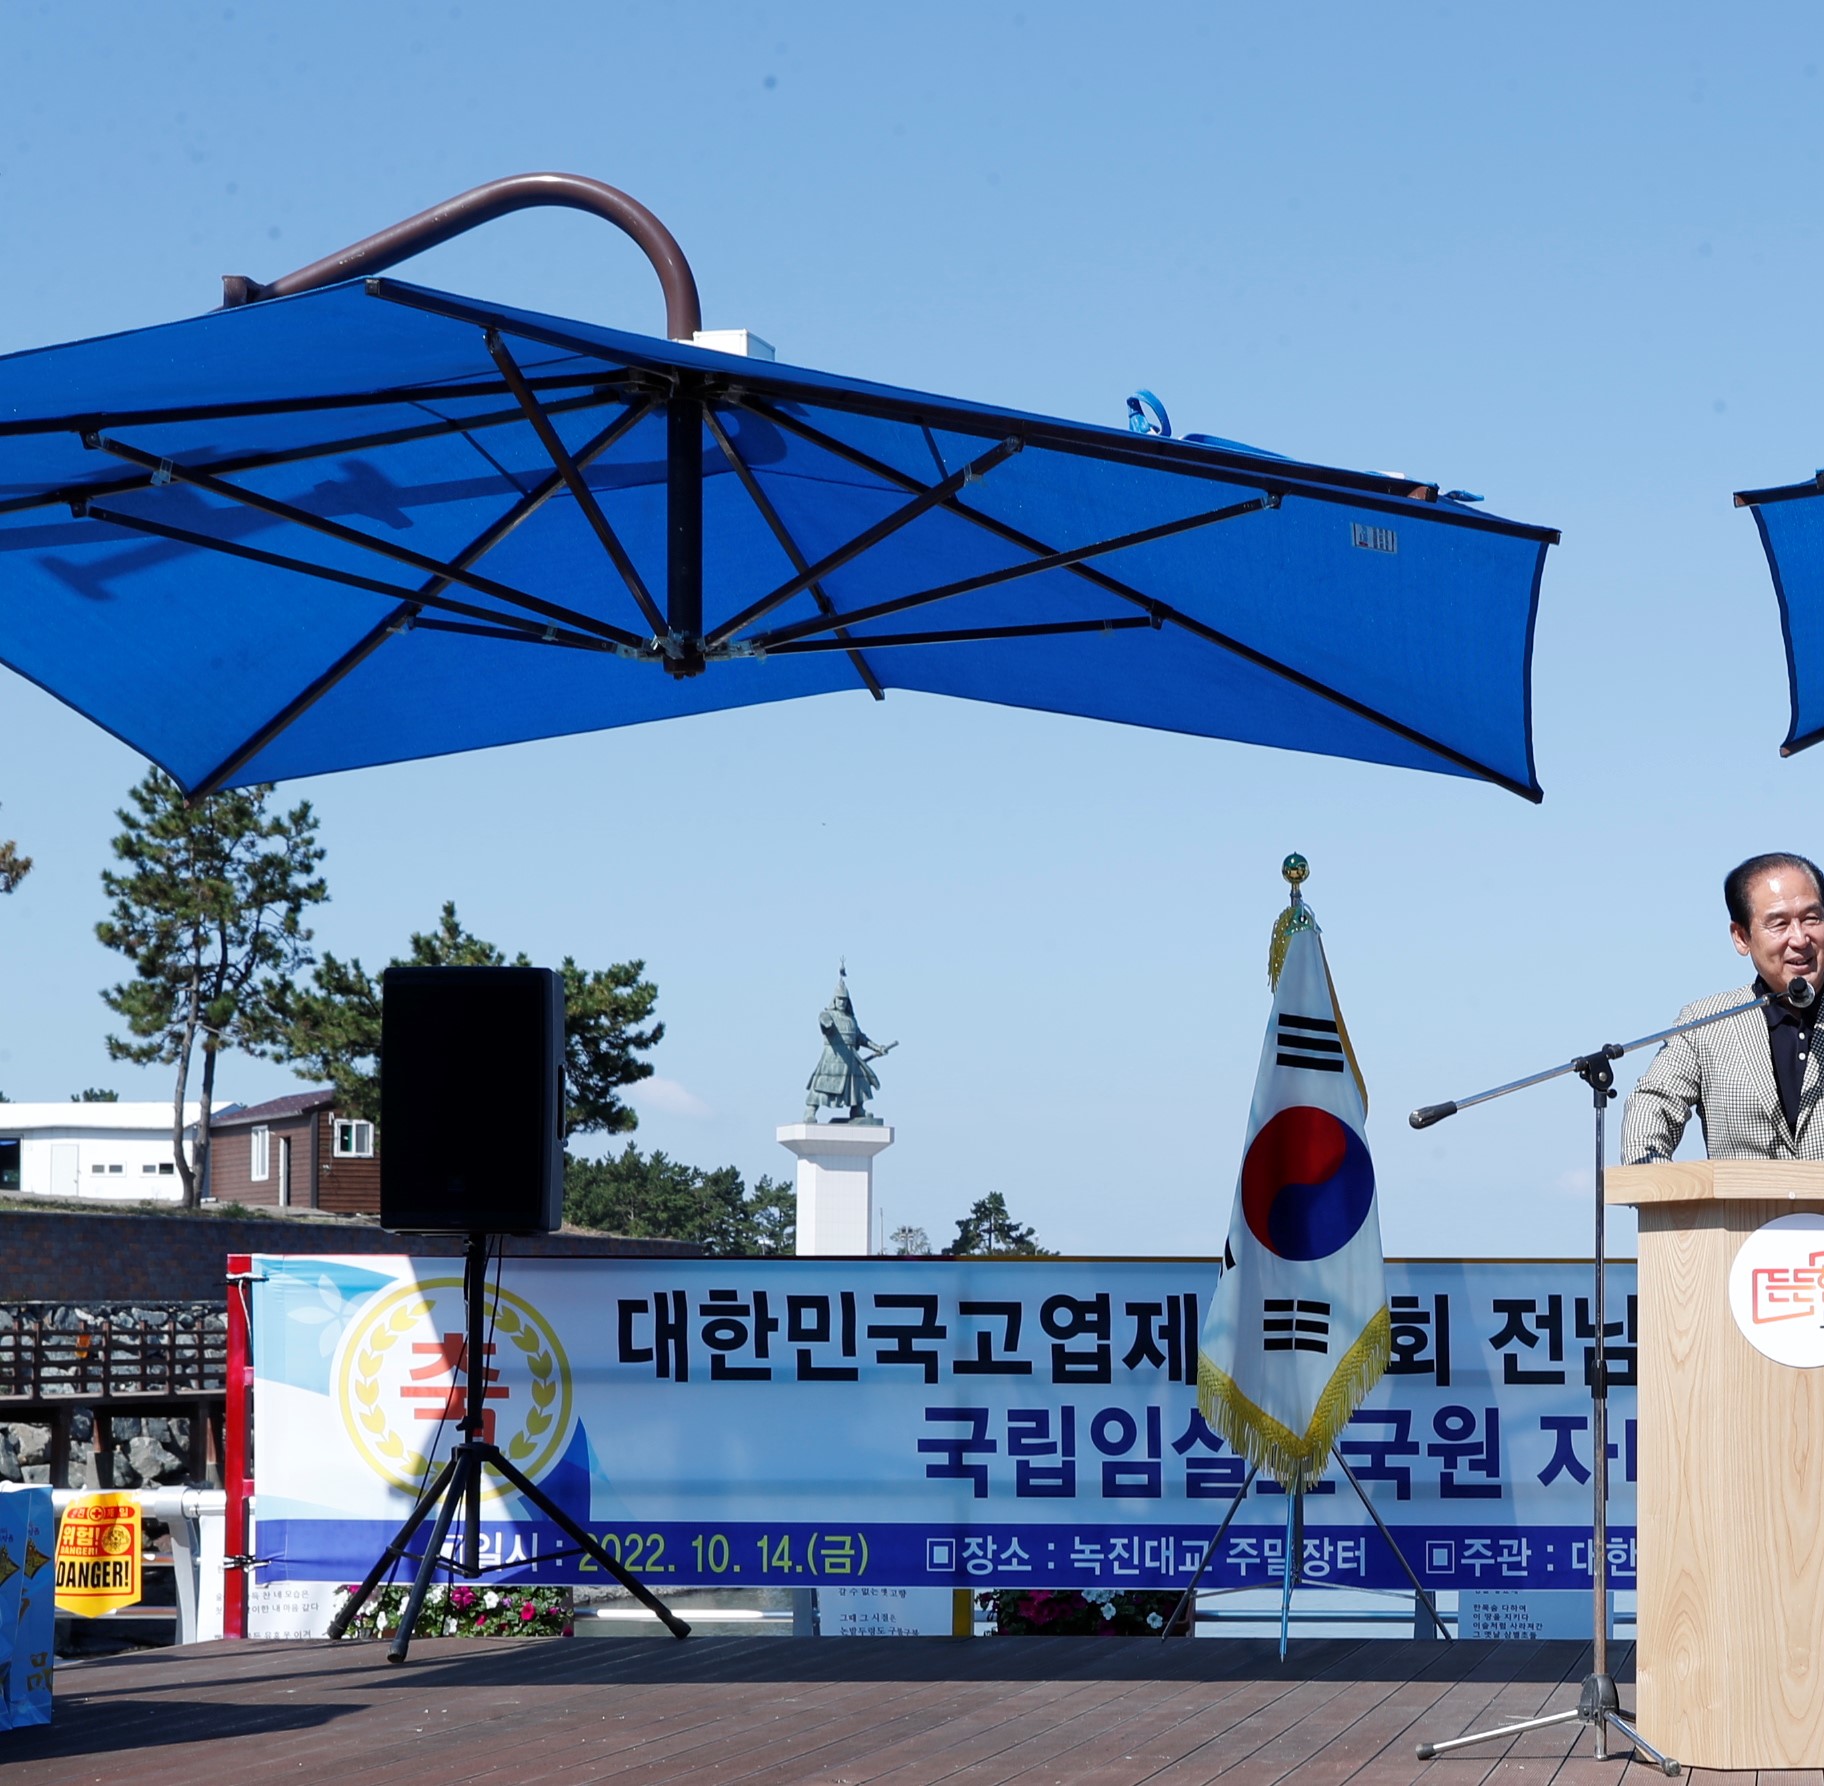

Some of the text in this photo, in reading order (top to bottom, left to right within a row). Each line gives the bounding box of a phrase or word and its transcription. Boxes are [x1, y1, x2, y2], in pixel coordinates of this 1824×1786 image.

[617, 1289, 1451, 1387] 대한민국고엽제회
[1488, 1294, 1638, 1387] 전남
[400, 1333, 510, 1447] 축
[917, 1405, 1502, 1501] 국립임실국원
[60, 1546, 98, 1556] DANGER!
[63, 1526, 101, 1546] 위험!
[478, 1532, 538, 1573] 일시
[579, 1533, 676, 1573] 2022.
[691, 1534, 741, 1573] 10.
[962, 1535, 1032, 1576] 장소
[1070, 1535, 1212, 1577] 녹진대교
[1226, 1536, 1367, 1578] 주말장터
[56, 1560, 129, 1588] DANGER!
[1460, 1537, 1532, 1577] 주관
[1571, 1537, 1638, 1577] 대한
